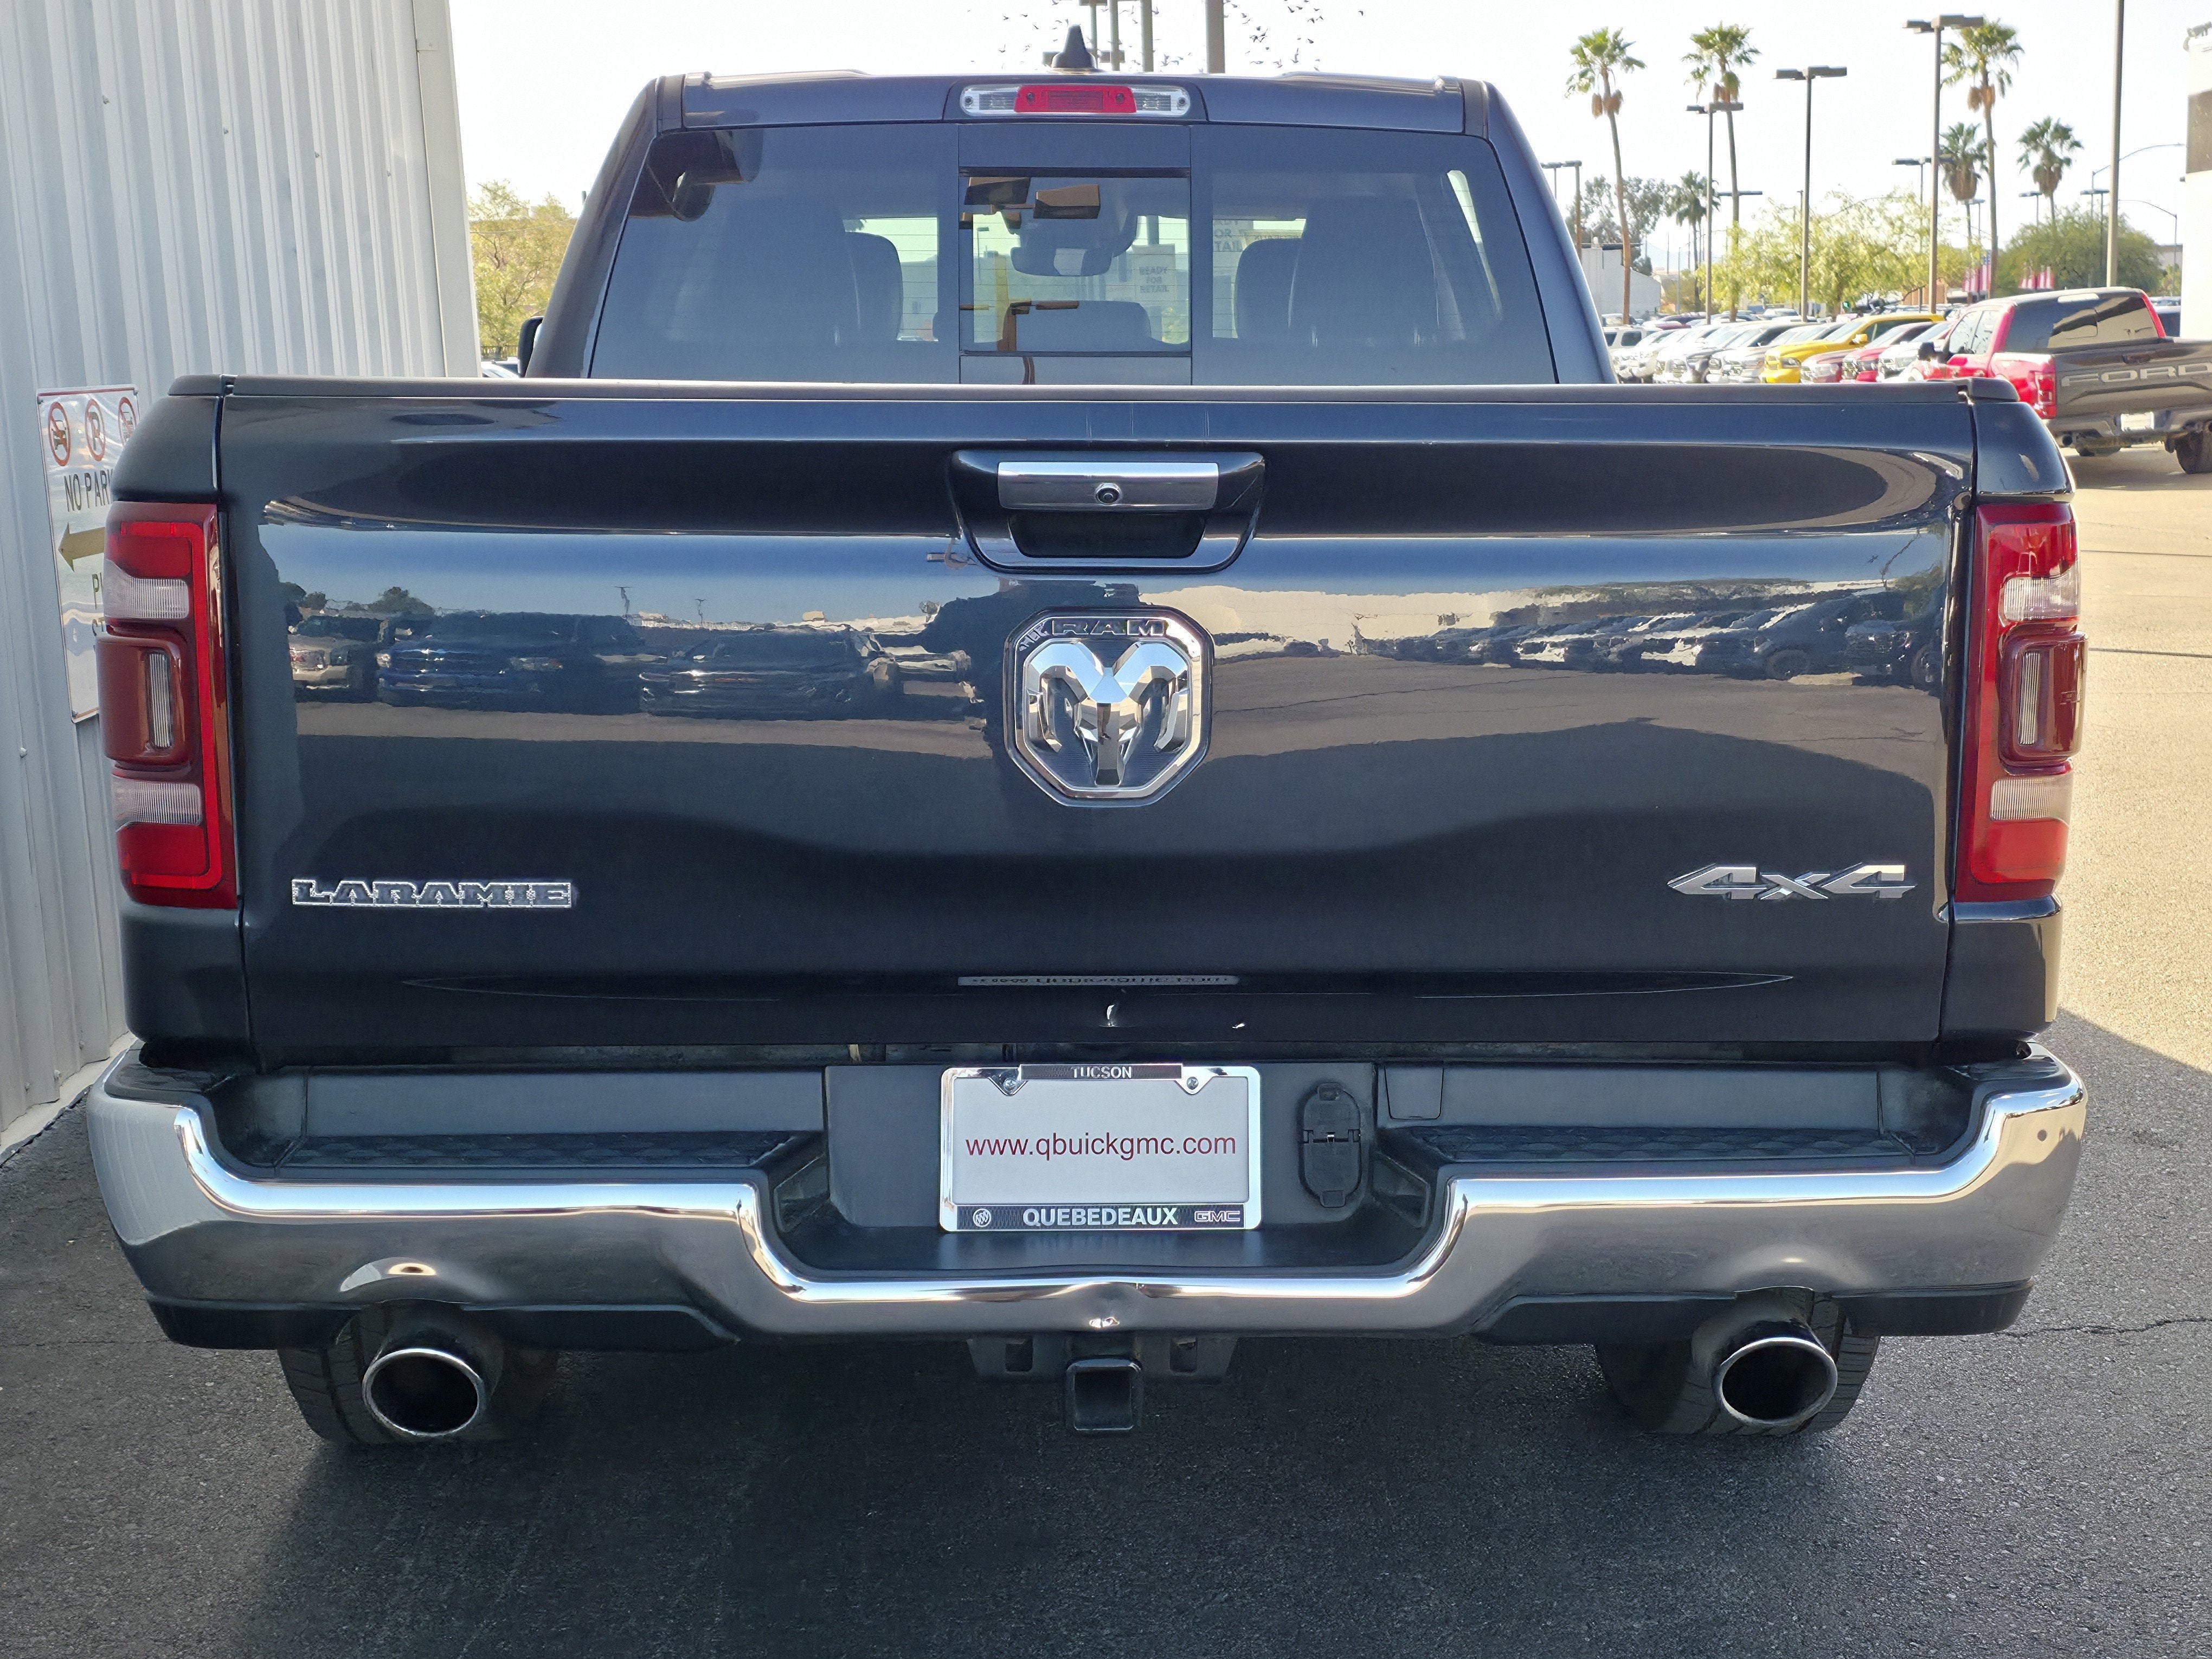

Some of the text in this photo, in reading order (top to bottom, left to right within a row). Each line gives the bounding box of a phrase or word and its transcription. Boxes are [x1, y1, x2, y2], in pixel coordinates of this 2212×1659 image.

[2061, 362, 2212, 387] FORD
[64, 473, 82, 512] NO
[1052, 619, 1166, 635] RAM
[291, 879, 571, 908] LARAMIE
[1071, 1066, 1133, 1079] TUCSON
[966, 1133, 1237, 1161] www.qbuickgmc.com
[1023, 1207, 1240, 1226] QUEBEDEAUX GMC
